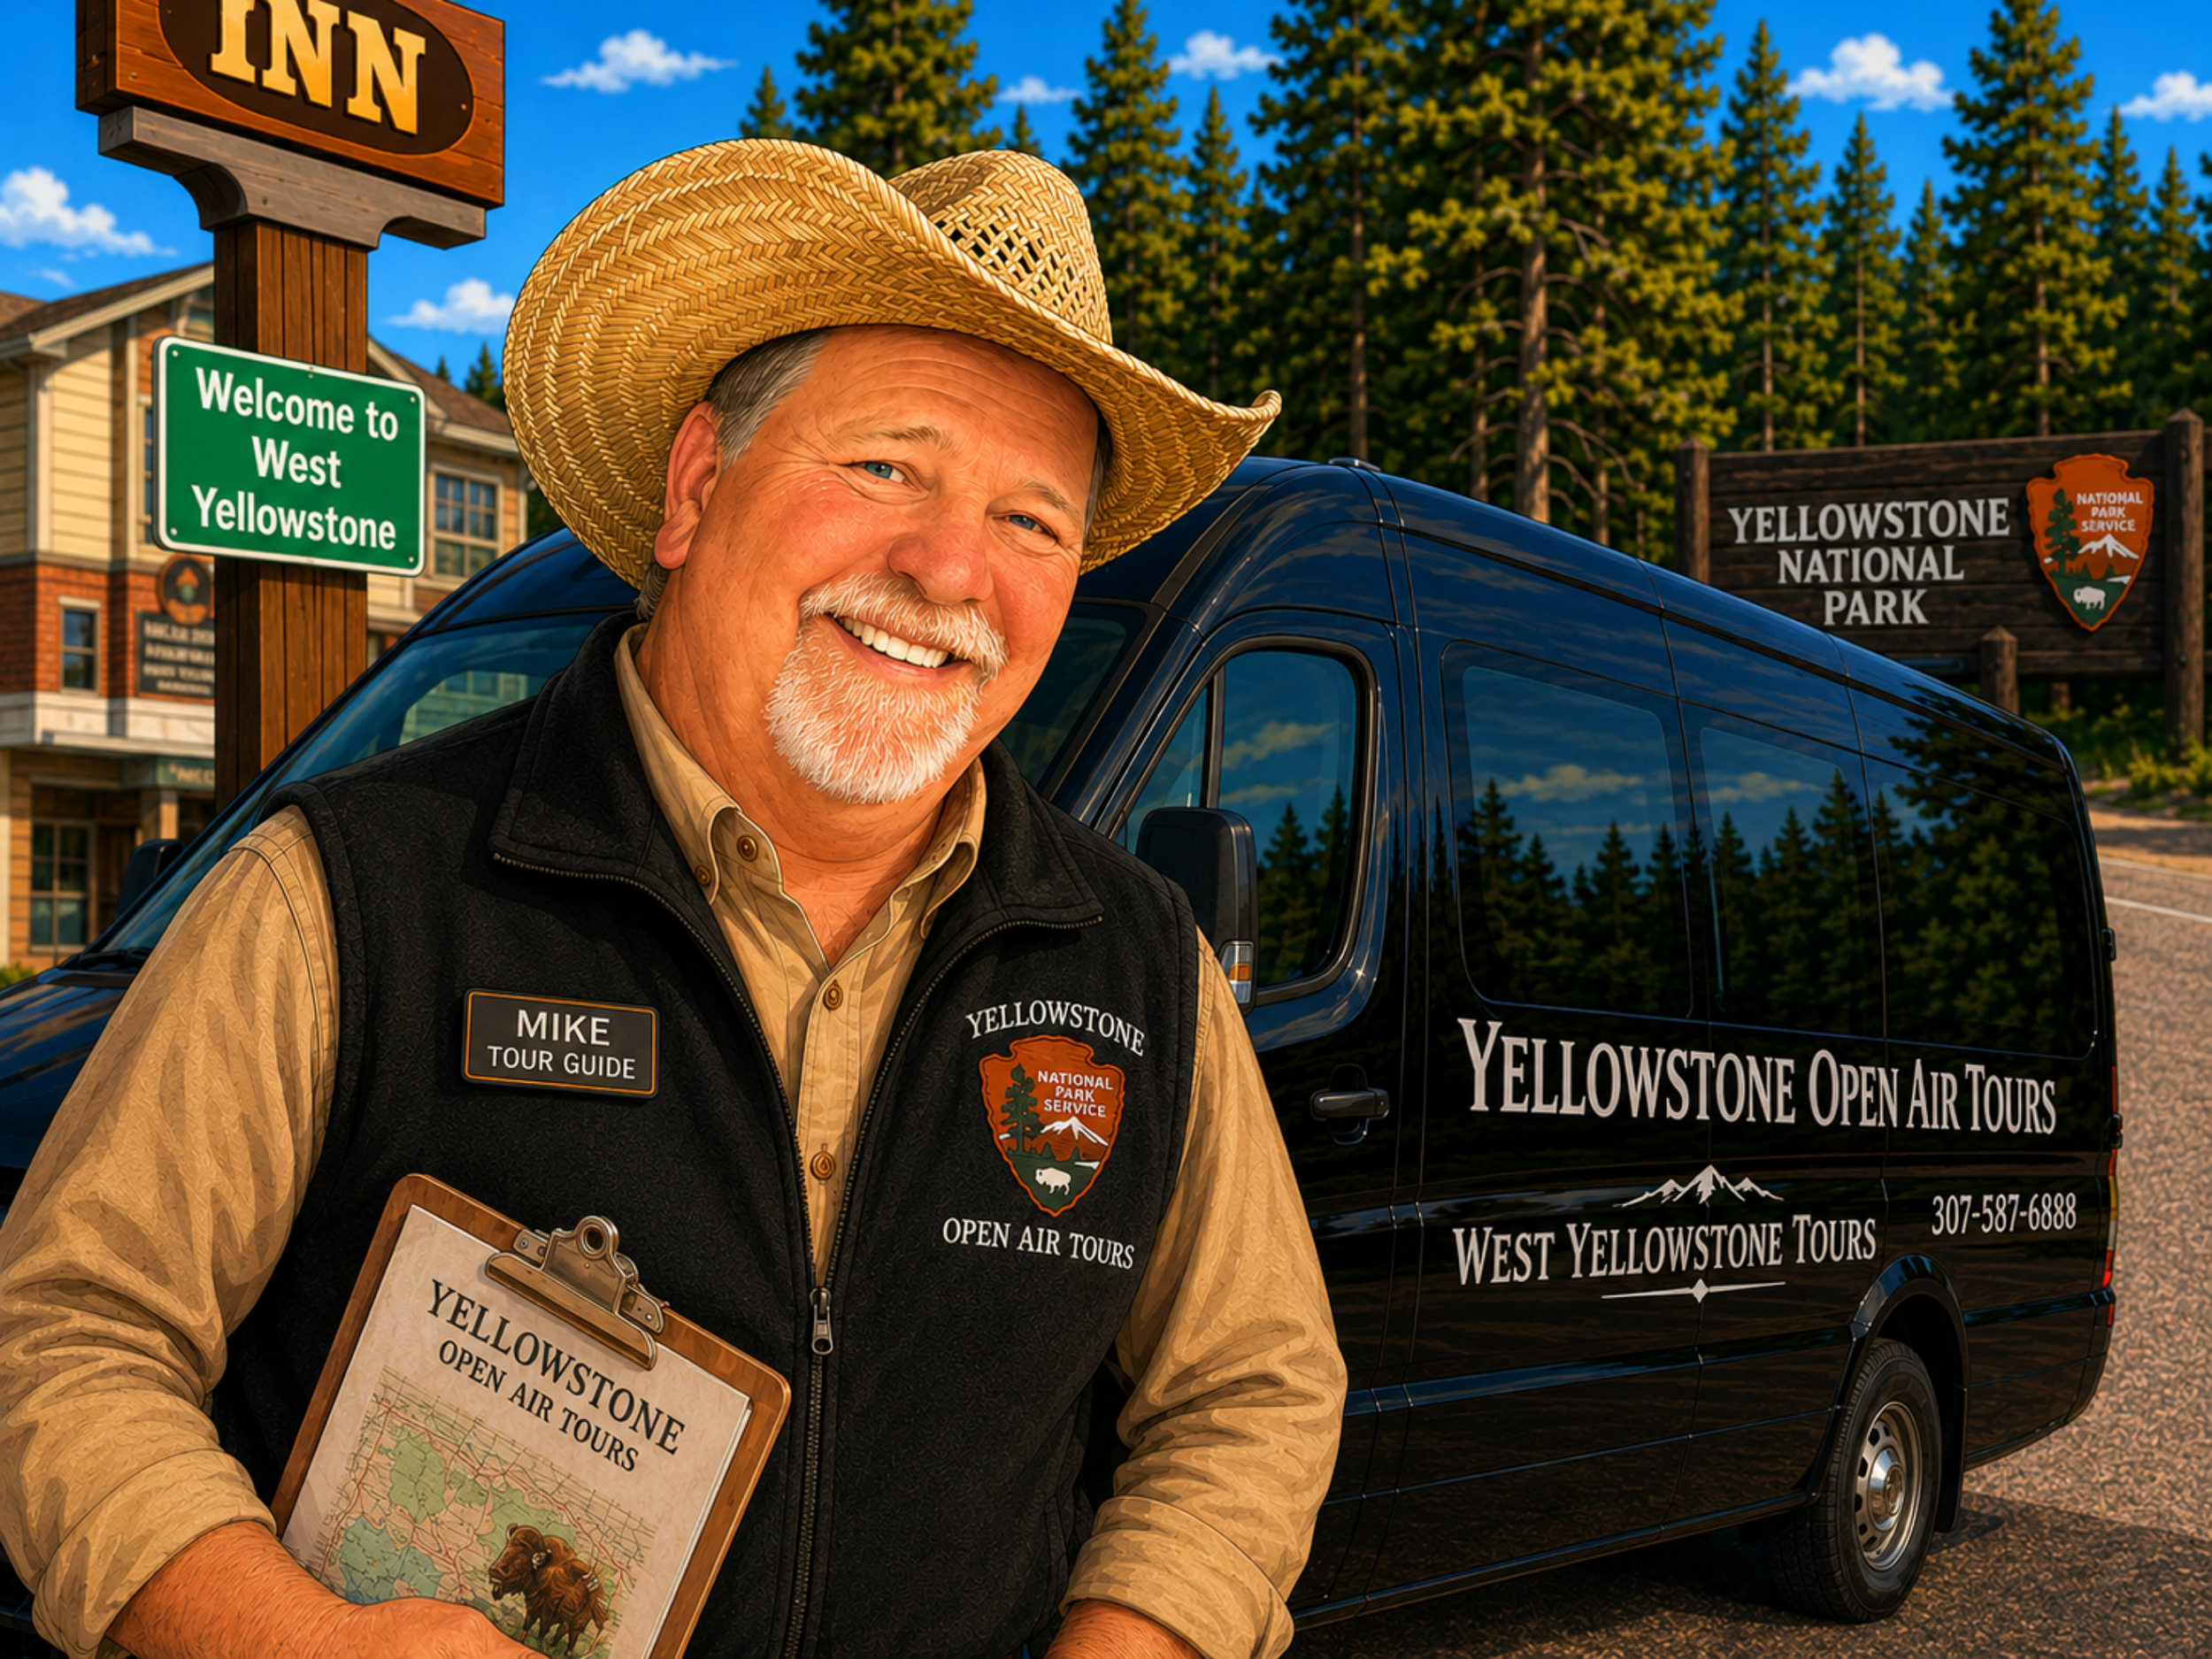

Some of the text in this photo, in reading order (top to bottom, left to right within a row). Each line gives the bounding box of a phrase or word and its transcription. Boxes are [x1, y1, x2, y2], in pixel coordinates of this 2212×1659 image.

[209, 0, 426, 134] INN
[196, 366, 398, 442] Welcome to
[251, 435, 342, 488] West
[191, 484, 396, 550] Yellowstone
[2077, 492, 2144, 504] NATIONAL
[2091, 506, 2125, 518] PARK
[1728, 498, 2010, 544] YELLOWSTONE
[2081, 519, 2135, 533] SERVICE
[1778, 546, 1964, 584] NATIONAL
[1824, 589, 1928, 626] PARK
[517, 1009, 611, 1047] MIKE
[965, 1000, 1145, 1057] YELLOWSTONE
[487, 1045, 635, 1079] TOUR GUIDE
[1038, 1070, 1115, 1091] NATIONAL
[1457, 1018, 2055, 1134] YELLOWSTONE OPEN AIR TOURS
[1043, 1098, 1107, 1118] SERVICE
[1055, 1085, 1095, 1103] PARK
[1932, 1192, 2077, 1235] 307-587-6888
[943, 1216, 1135, 1271] OPEN AIR TOURS
[1452, 1214, 1876, 1286] WEST YELLOWSTONE TOURS
[427, 1279, 685, 1455] YELLOWSTONE
[439, 1340, 640, 1472] OPEN AIR TOURS
